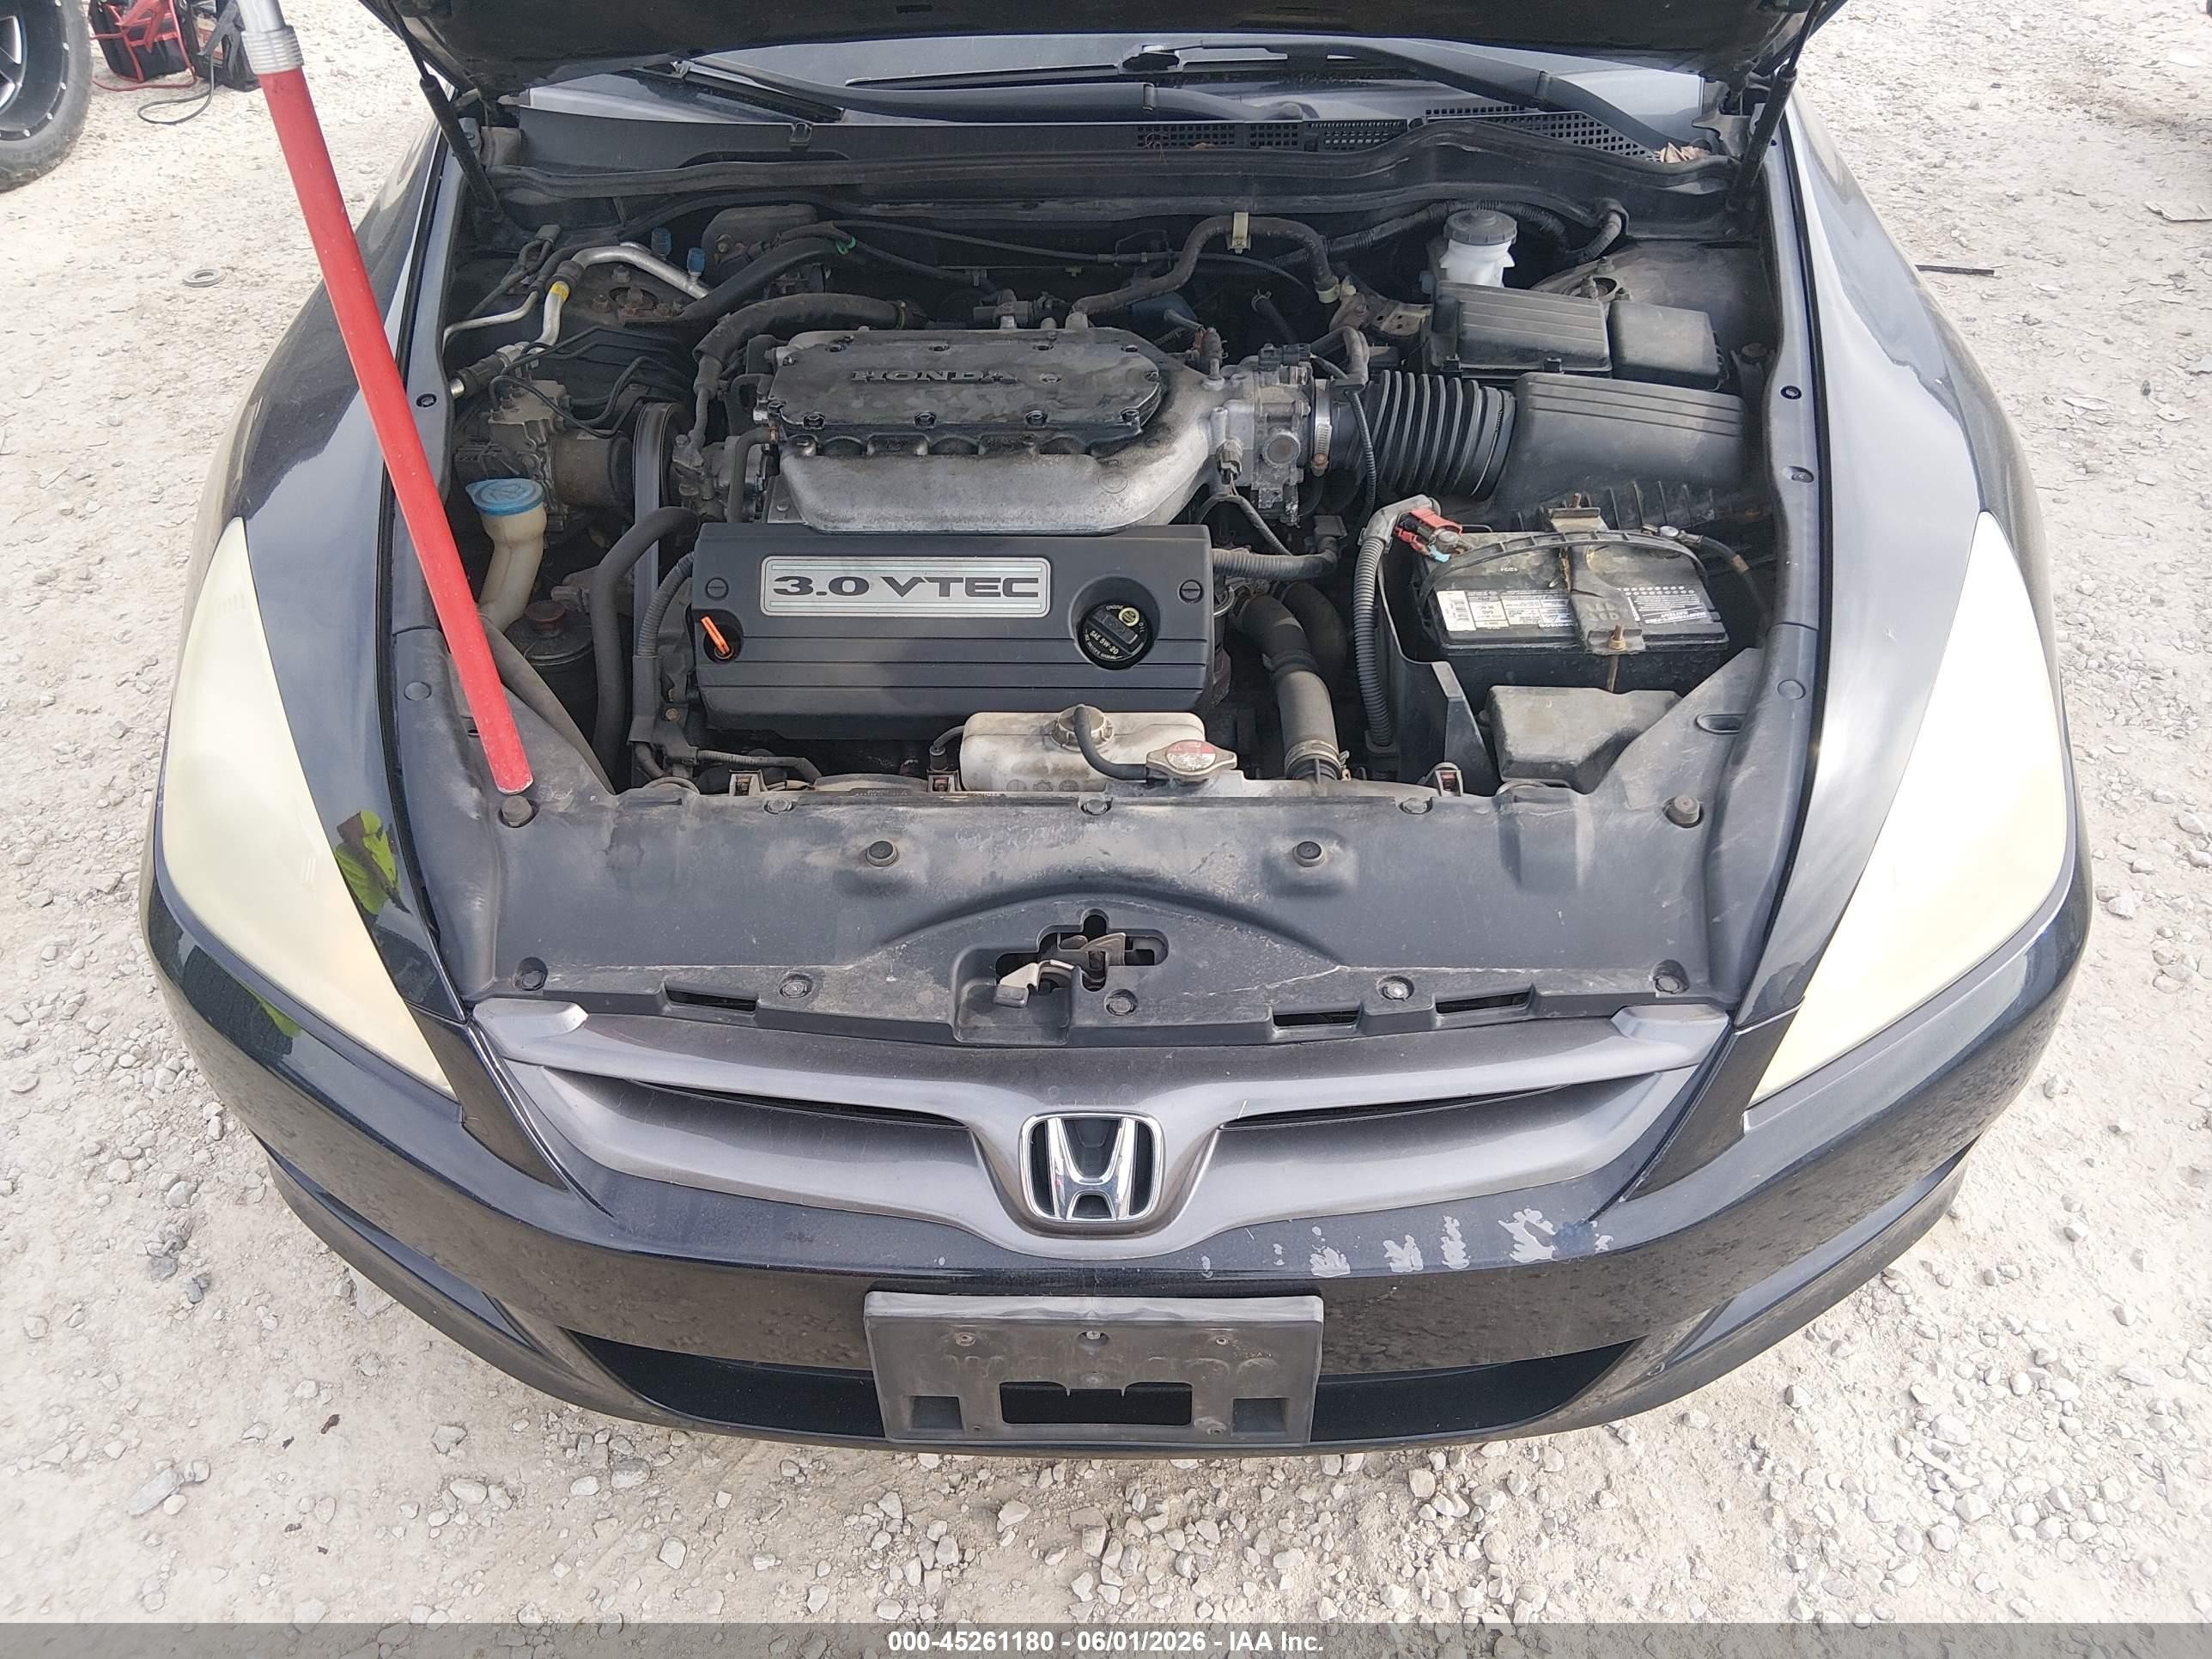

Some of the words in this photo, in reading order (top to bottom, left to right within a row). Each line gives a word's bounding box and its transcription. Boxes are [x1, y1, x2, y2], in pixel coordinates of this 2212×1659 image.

[851, 370, 1018, 385] HONDA
[773, 576, 870, 597] 3.0
[881, 576, 1039, 598] VTEC
[1090, 630, 1102, 641] SAE
[1099, 638, 1120, 655] 5W-20
